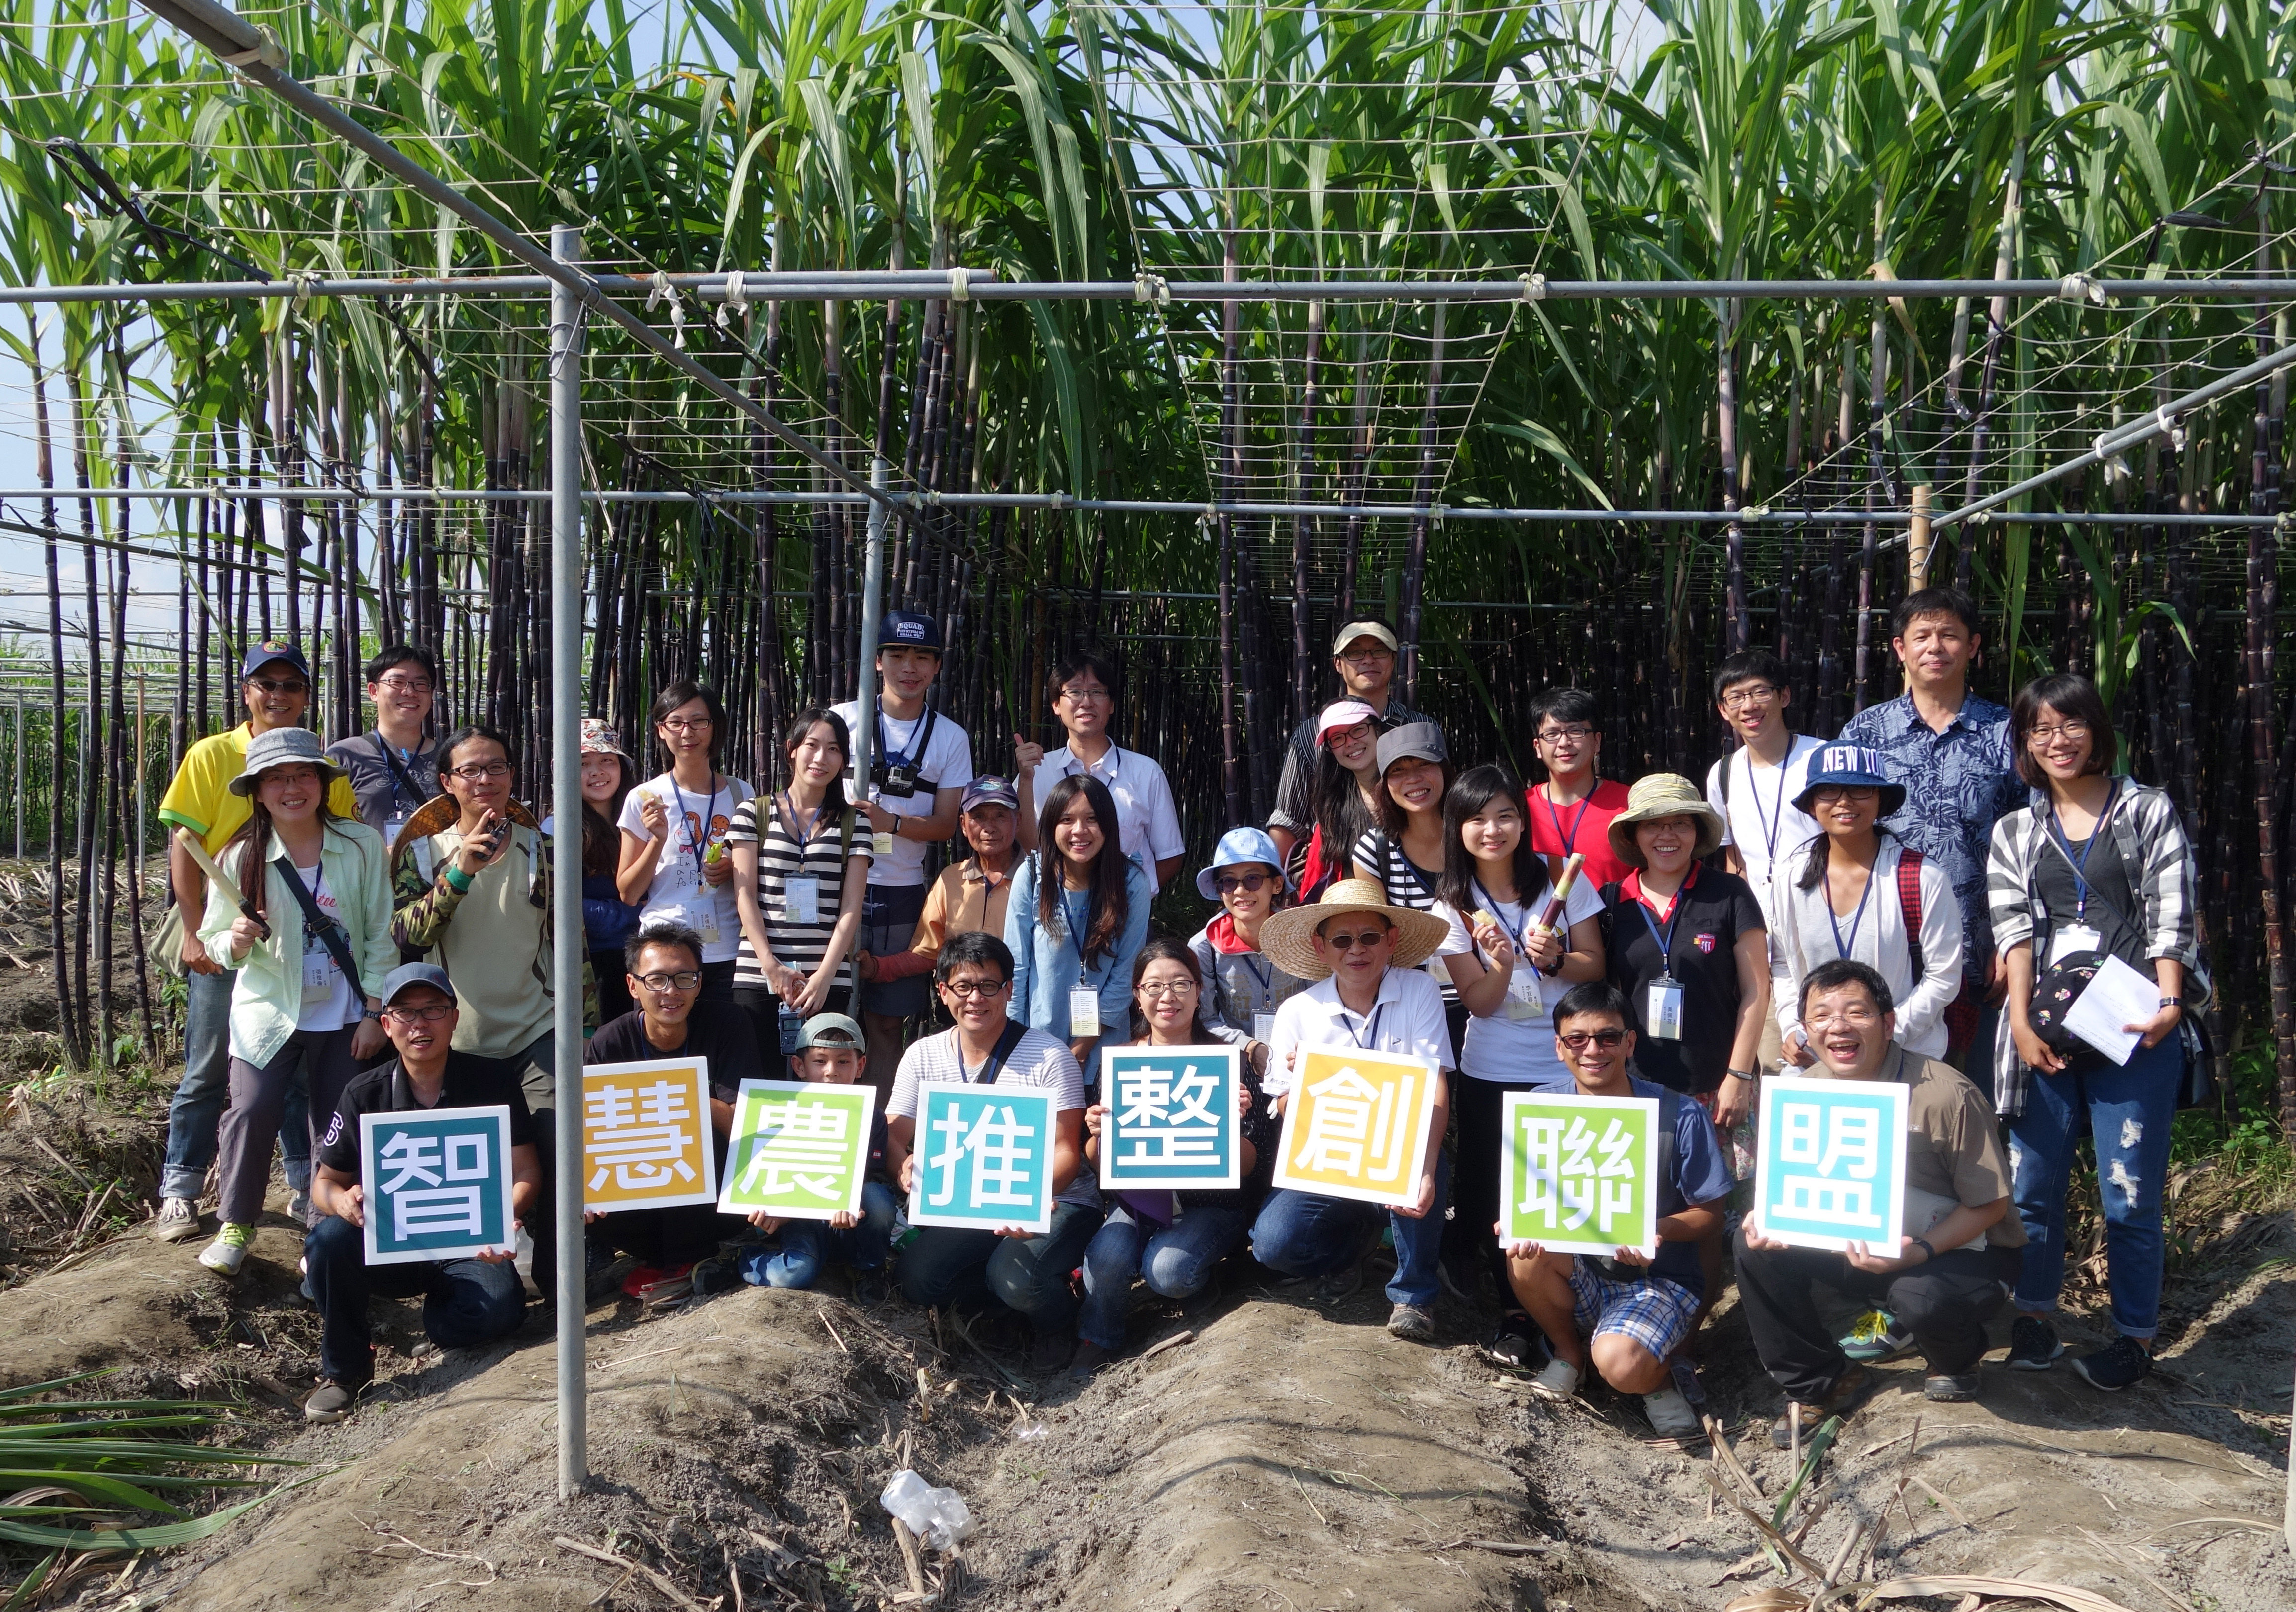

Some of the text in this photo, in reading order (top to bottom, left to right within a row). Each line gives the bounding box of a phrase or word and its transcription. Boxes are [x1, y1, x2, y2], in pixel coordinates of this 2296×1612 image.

[1822, 745, 1858, 772] NEW
[585, 1081, 696, 1191] 慧
[739, 1100, 848, 1201] 農
[929, 1103, 1034, 1208] 推
[1117, 1065, 1221, 1166] 整
[1294, 1066, 1415, 1182] 創
[1771, 1103, 1882, 1228] 盟
[380, 1132, 489, 1241] 智
[1518, 1116, 1635, 1232] 聯
